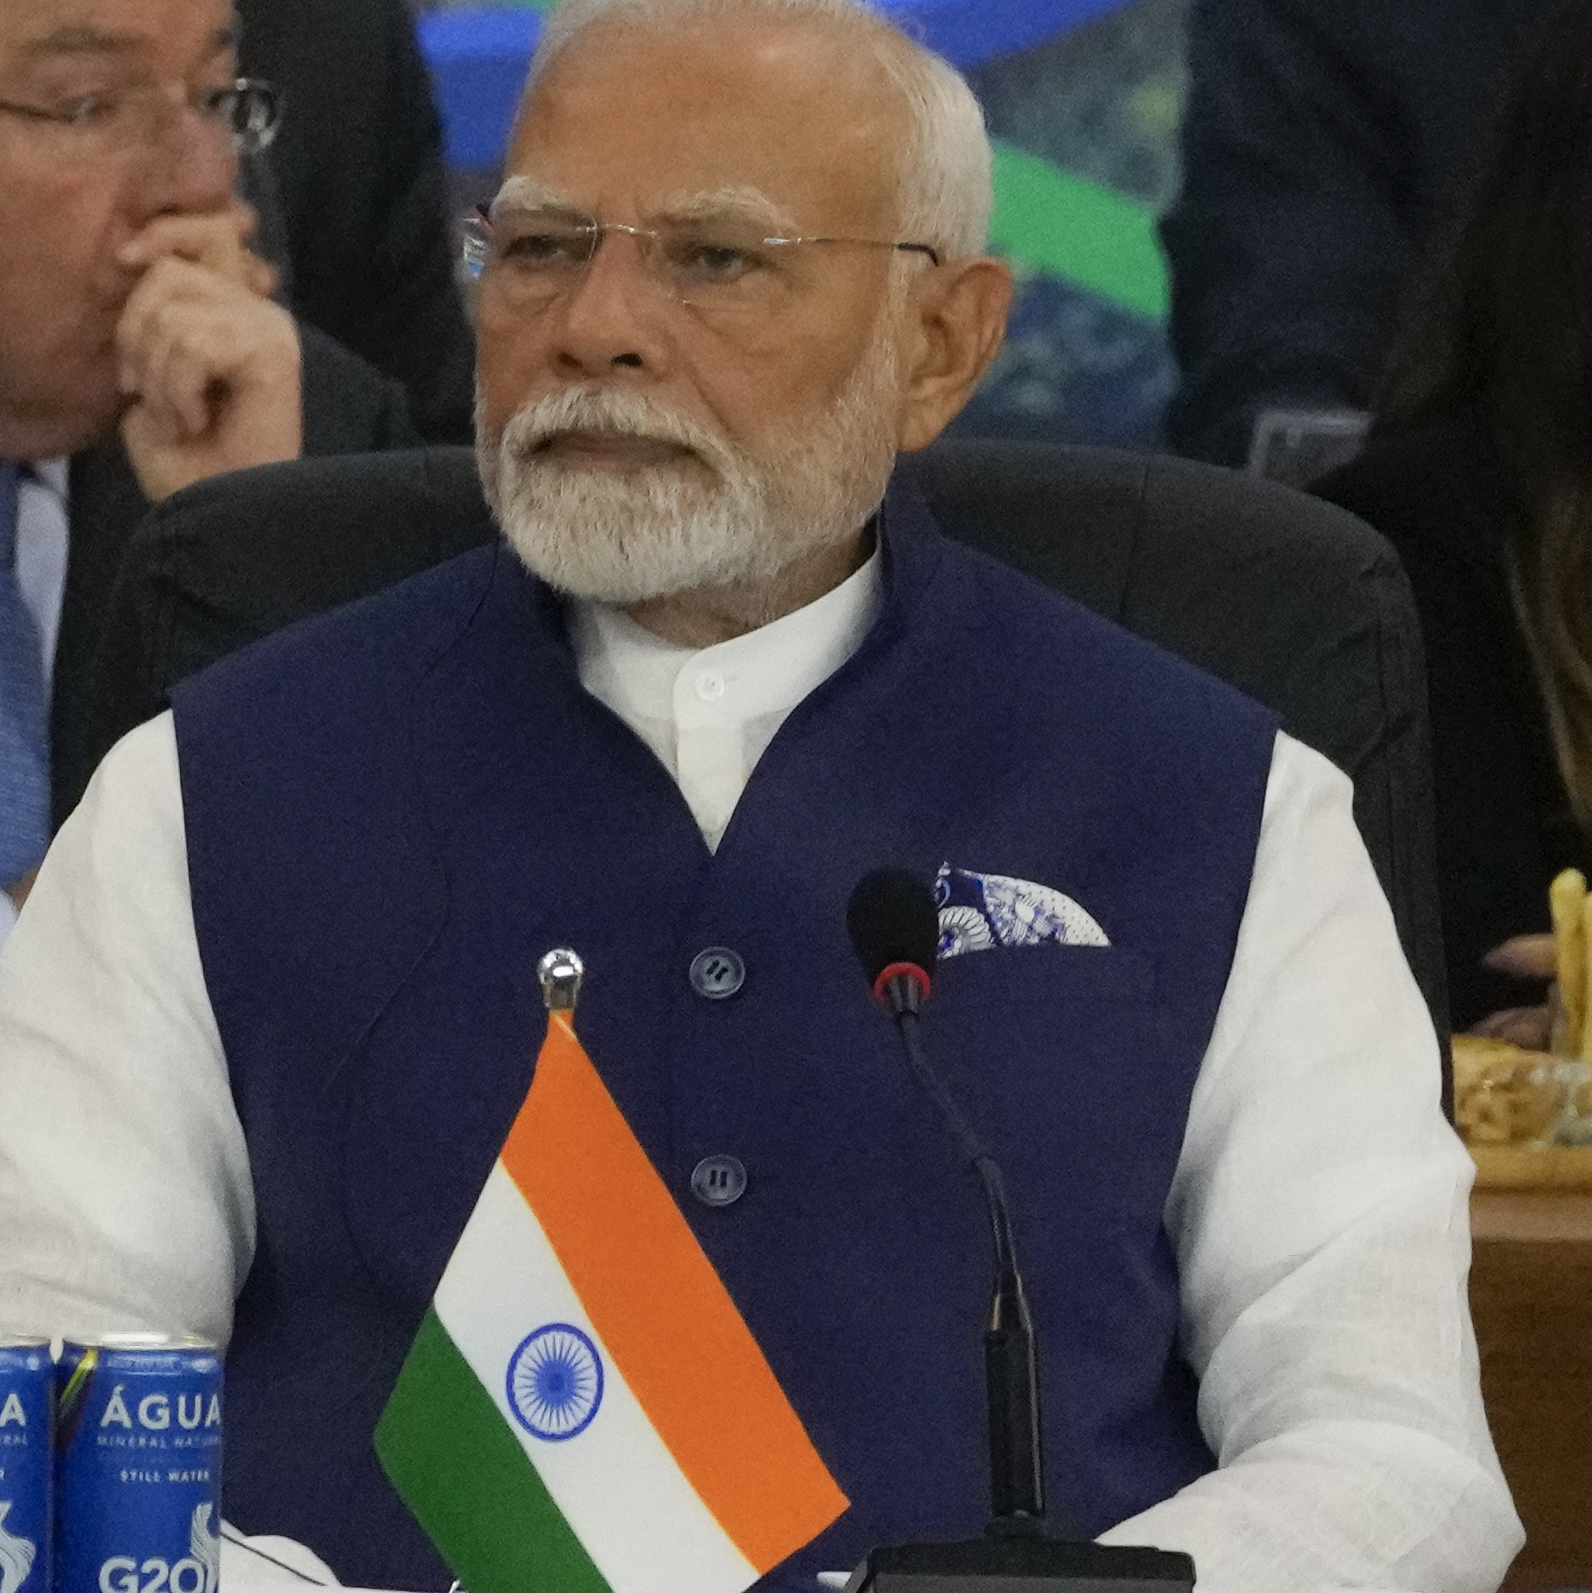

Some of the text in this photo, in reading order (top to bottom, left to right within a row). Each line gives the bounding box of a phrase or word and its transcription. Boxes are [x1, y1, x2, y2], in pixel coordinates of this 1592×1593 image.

[100, 1384, 221, 1430] ÁGUA
[120, 1469, 161, 1482] STILL
[99, 1556, 204, 1593] G20
